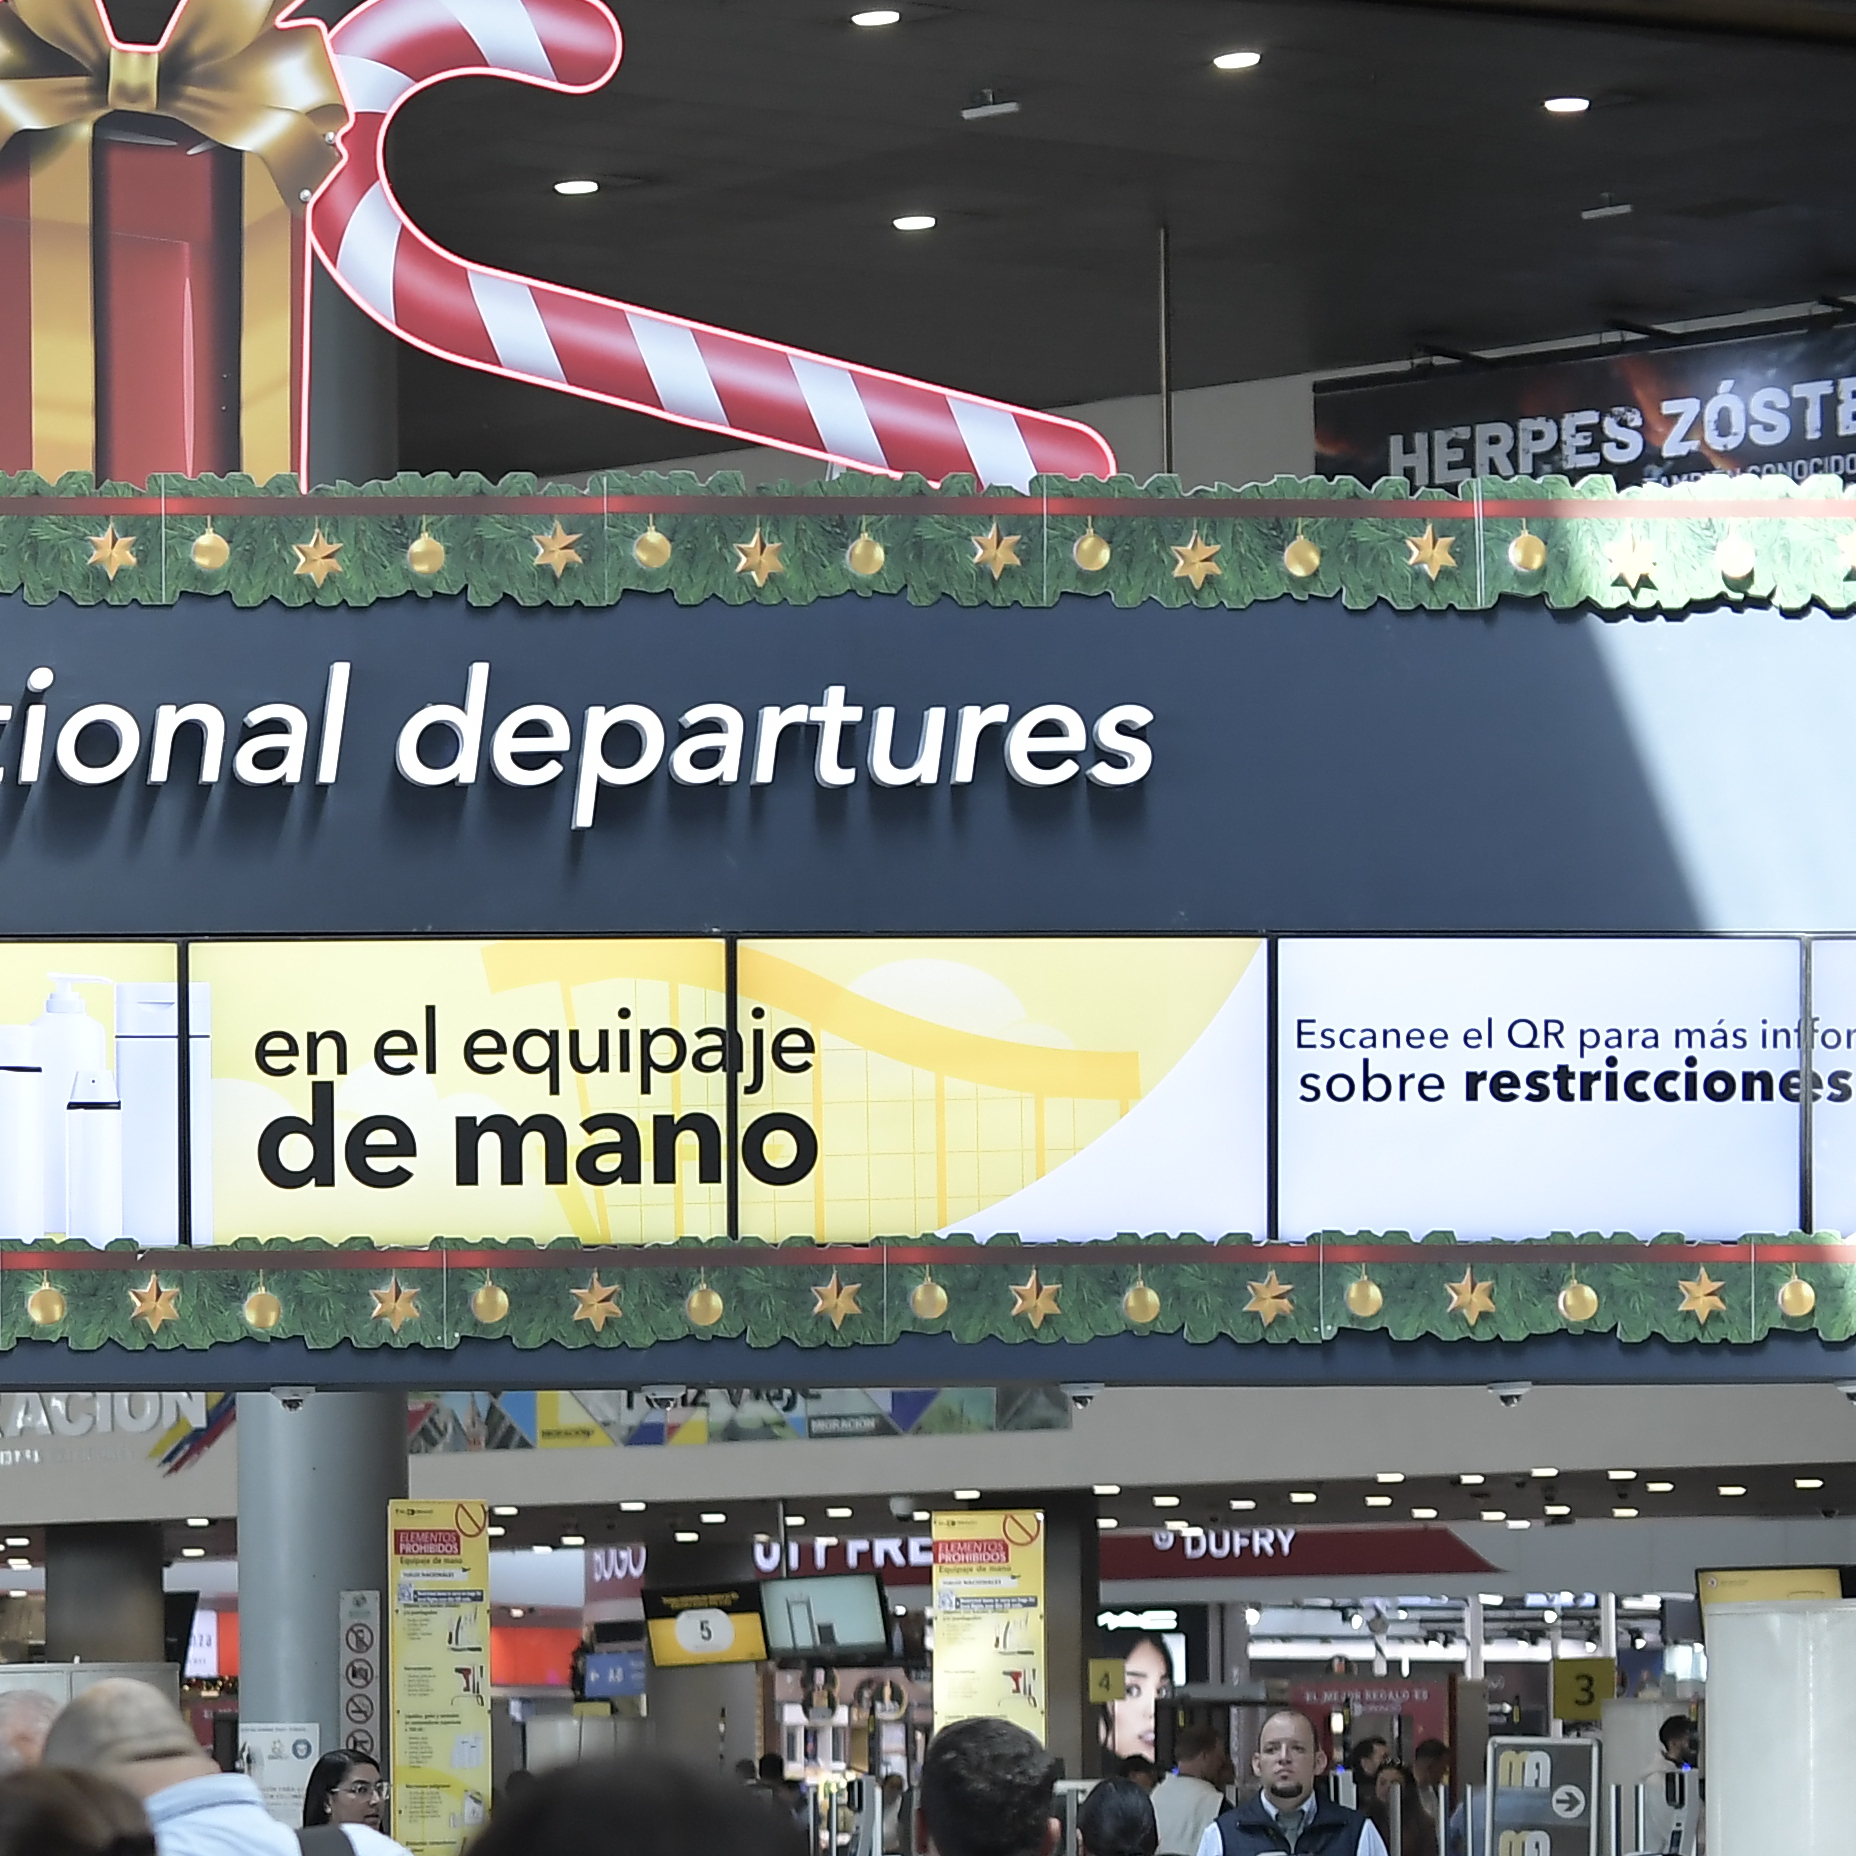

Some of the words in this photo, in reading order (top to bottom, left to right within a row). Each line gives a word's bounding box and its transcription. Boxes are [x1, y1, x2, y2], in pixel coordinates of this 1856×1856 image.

[1388, 405, 1645, 488] HERPES
[395, 662, 1155, 831] departures
[255, 1027, 347, 1078] en
[373, 1004, 437, 1076] el
[462, 1006, 816, 1096] equipaje
[1295, 1018, 1449, 1050] Escanee
[1463, 1016, 1493, 1050] el
[1507, 1018, 1566, 1051] QR
[1579, 1024, 1660, 1058] para
[1674, 1018, 1748, 1050] más
[1298, 1058, 1445, 1103] sobre
[1464, 1055, 1854, 1103] restricciones
[256, 1079, 417, 1190] de
[455, 1110, 819, 1189] mano
[399, 1531, 457, 1543] ELEMENTOS
[399, 1543, 459, 1554] PROHIBIDOS
[938, 1541, 1005, 1552] ELEMENTOS
[1184, 1528, 1297, 1560] DUFRY
[938, 1551, 1007, 1564] PROHIBIDOS
[699, 1619, 713, 1642] 5
[1097, 1669, 1113, 1693] 4
[1575, 1674, 1595, 1706] 3
